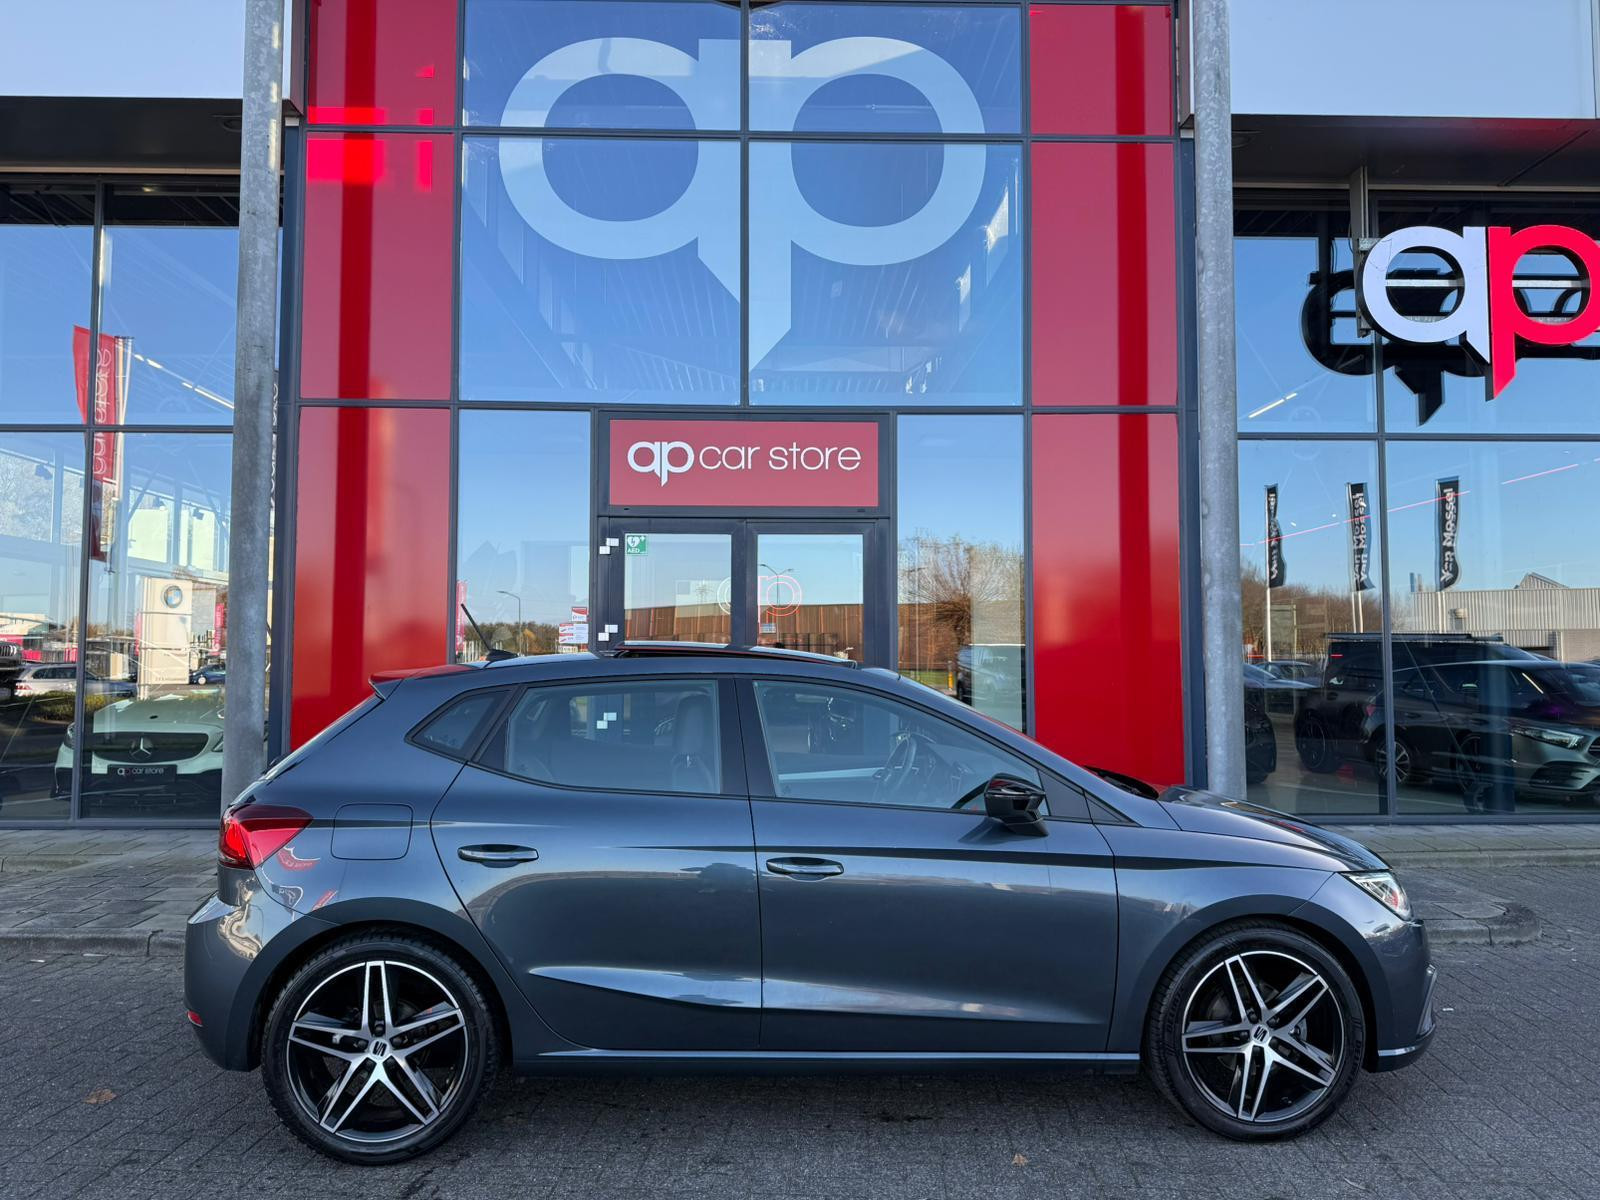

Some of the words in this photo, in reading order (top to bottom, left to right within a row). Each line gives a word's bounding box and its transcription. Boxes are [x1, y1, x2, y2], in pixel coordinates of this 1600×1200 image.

[1362, 224, 1600, 400] ap
[627, 441, 694, 487] ap
[699, 445, 760, 470] car
[768, 442, 861, 471] store
